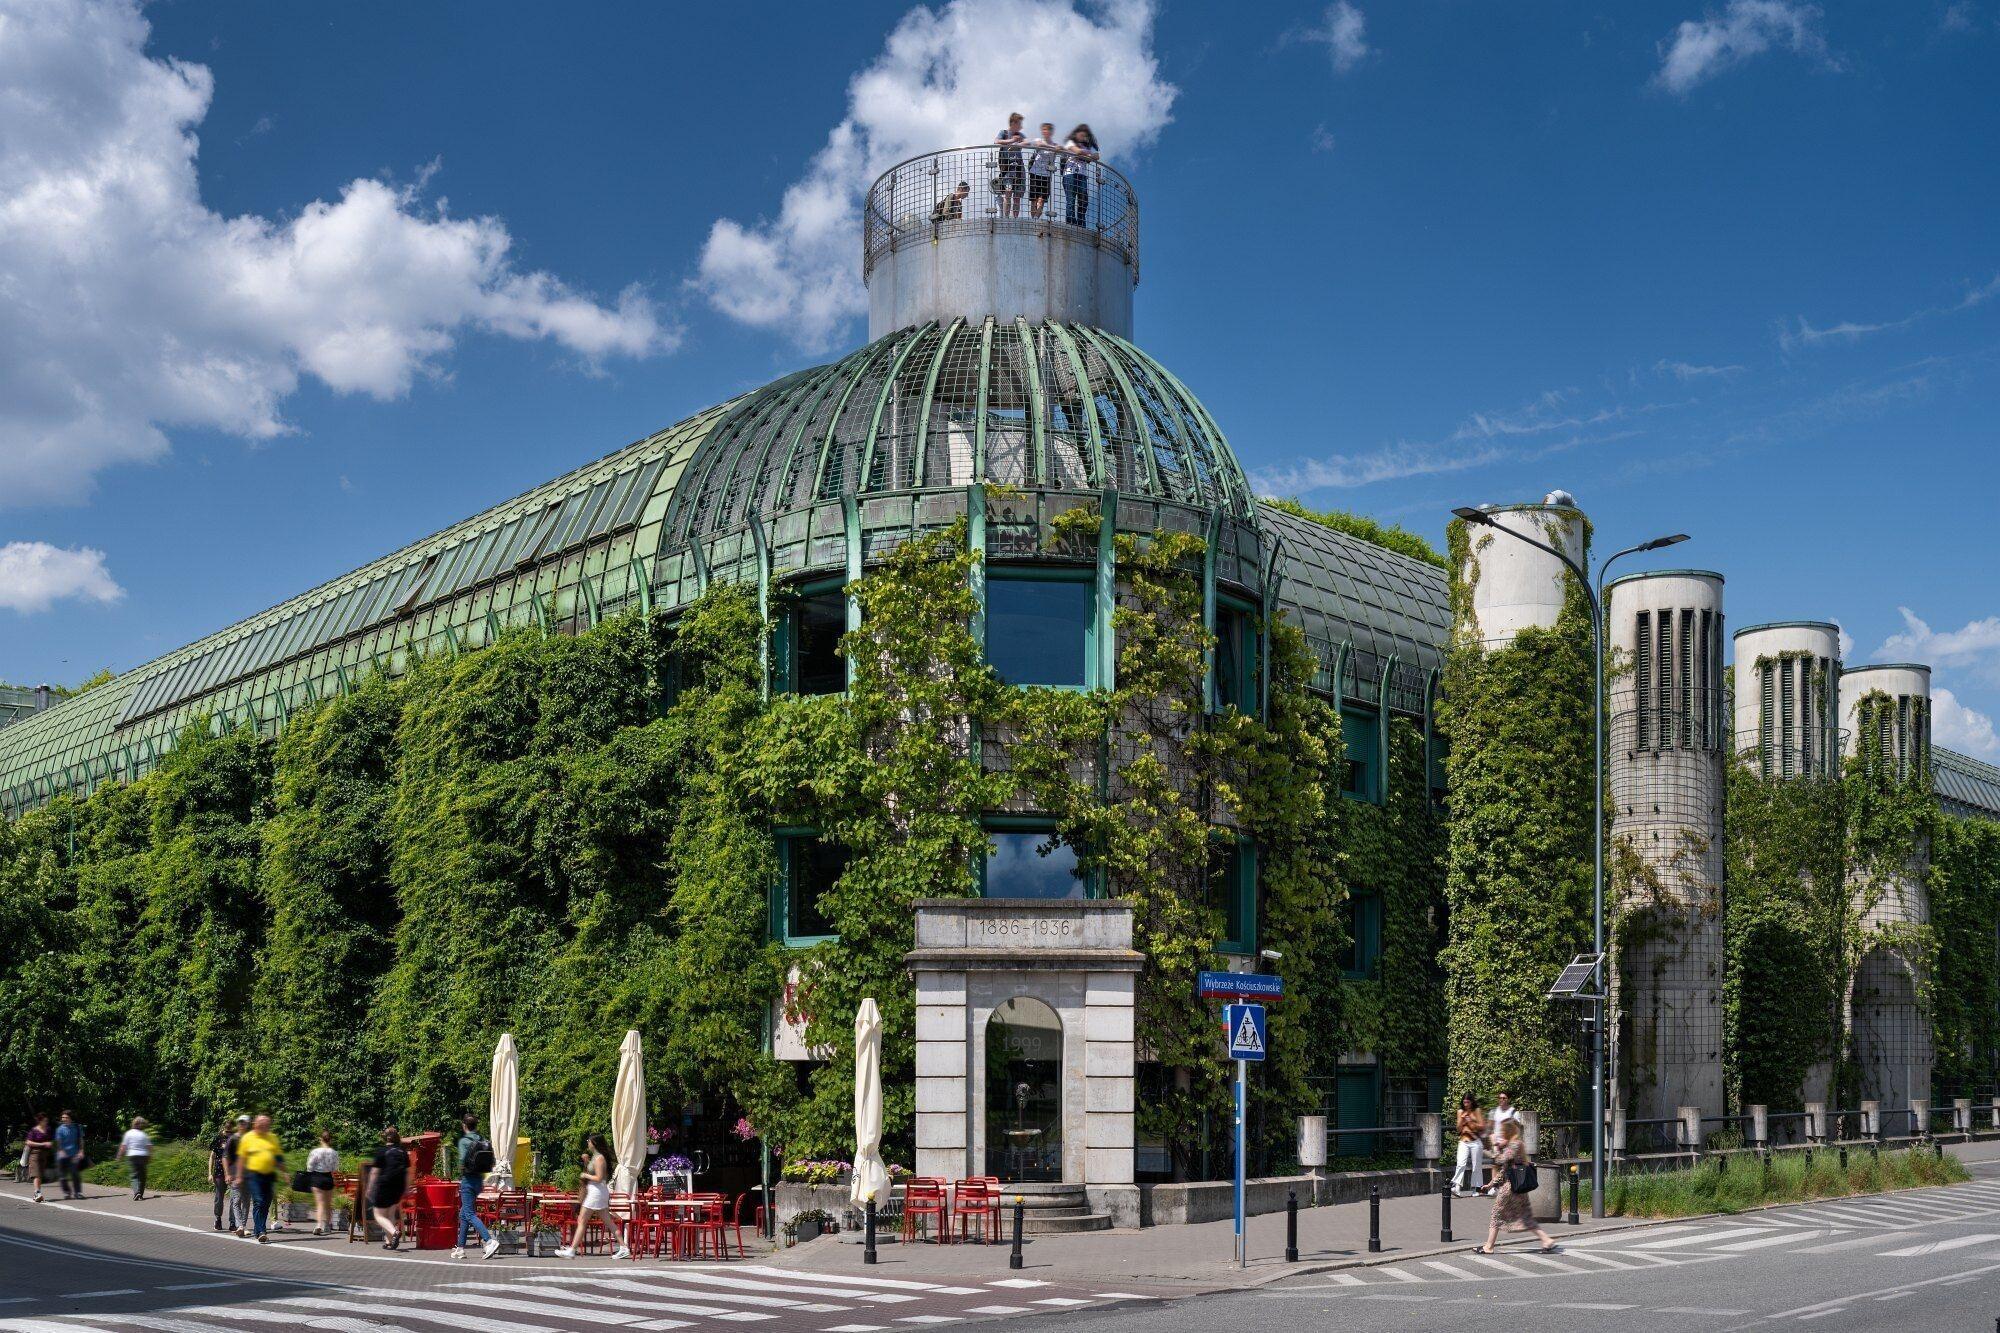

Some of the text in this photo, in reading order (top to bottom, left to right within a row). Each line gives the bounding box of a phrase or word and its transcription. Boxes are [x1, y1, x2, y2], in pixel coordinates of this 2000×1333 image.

[979, 919, 1070, 935] 1886-1936
[1204, 979, 1280, 993] Wybrzeże Kościuszkowskie
[1003, 1036, 1042, 1052] 1999
